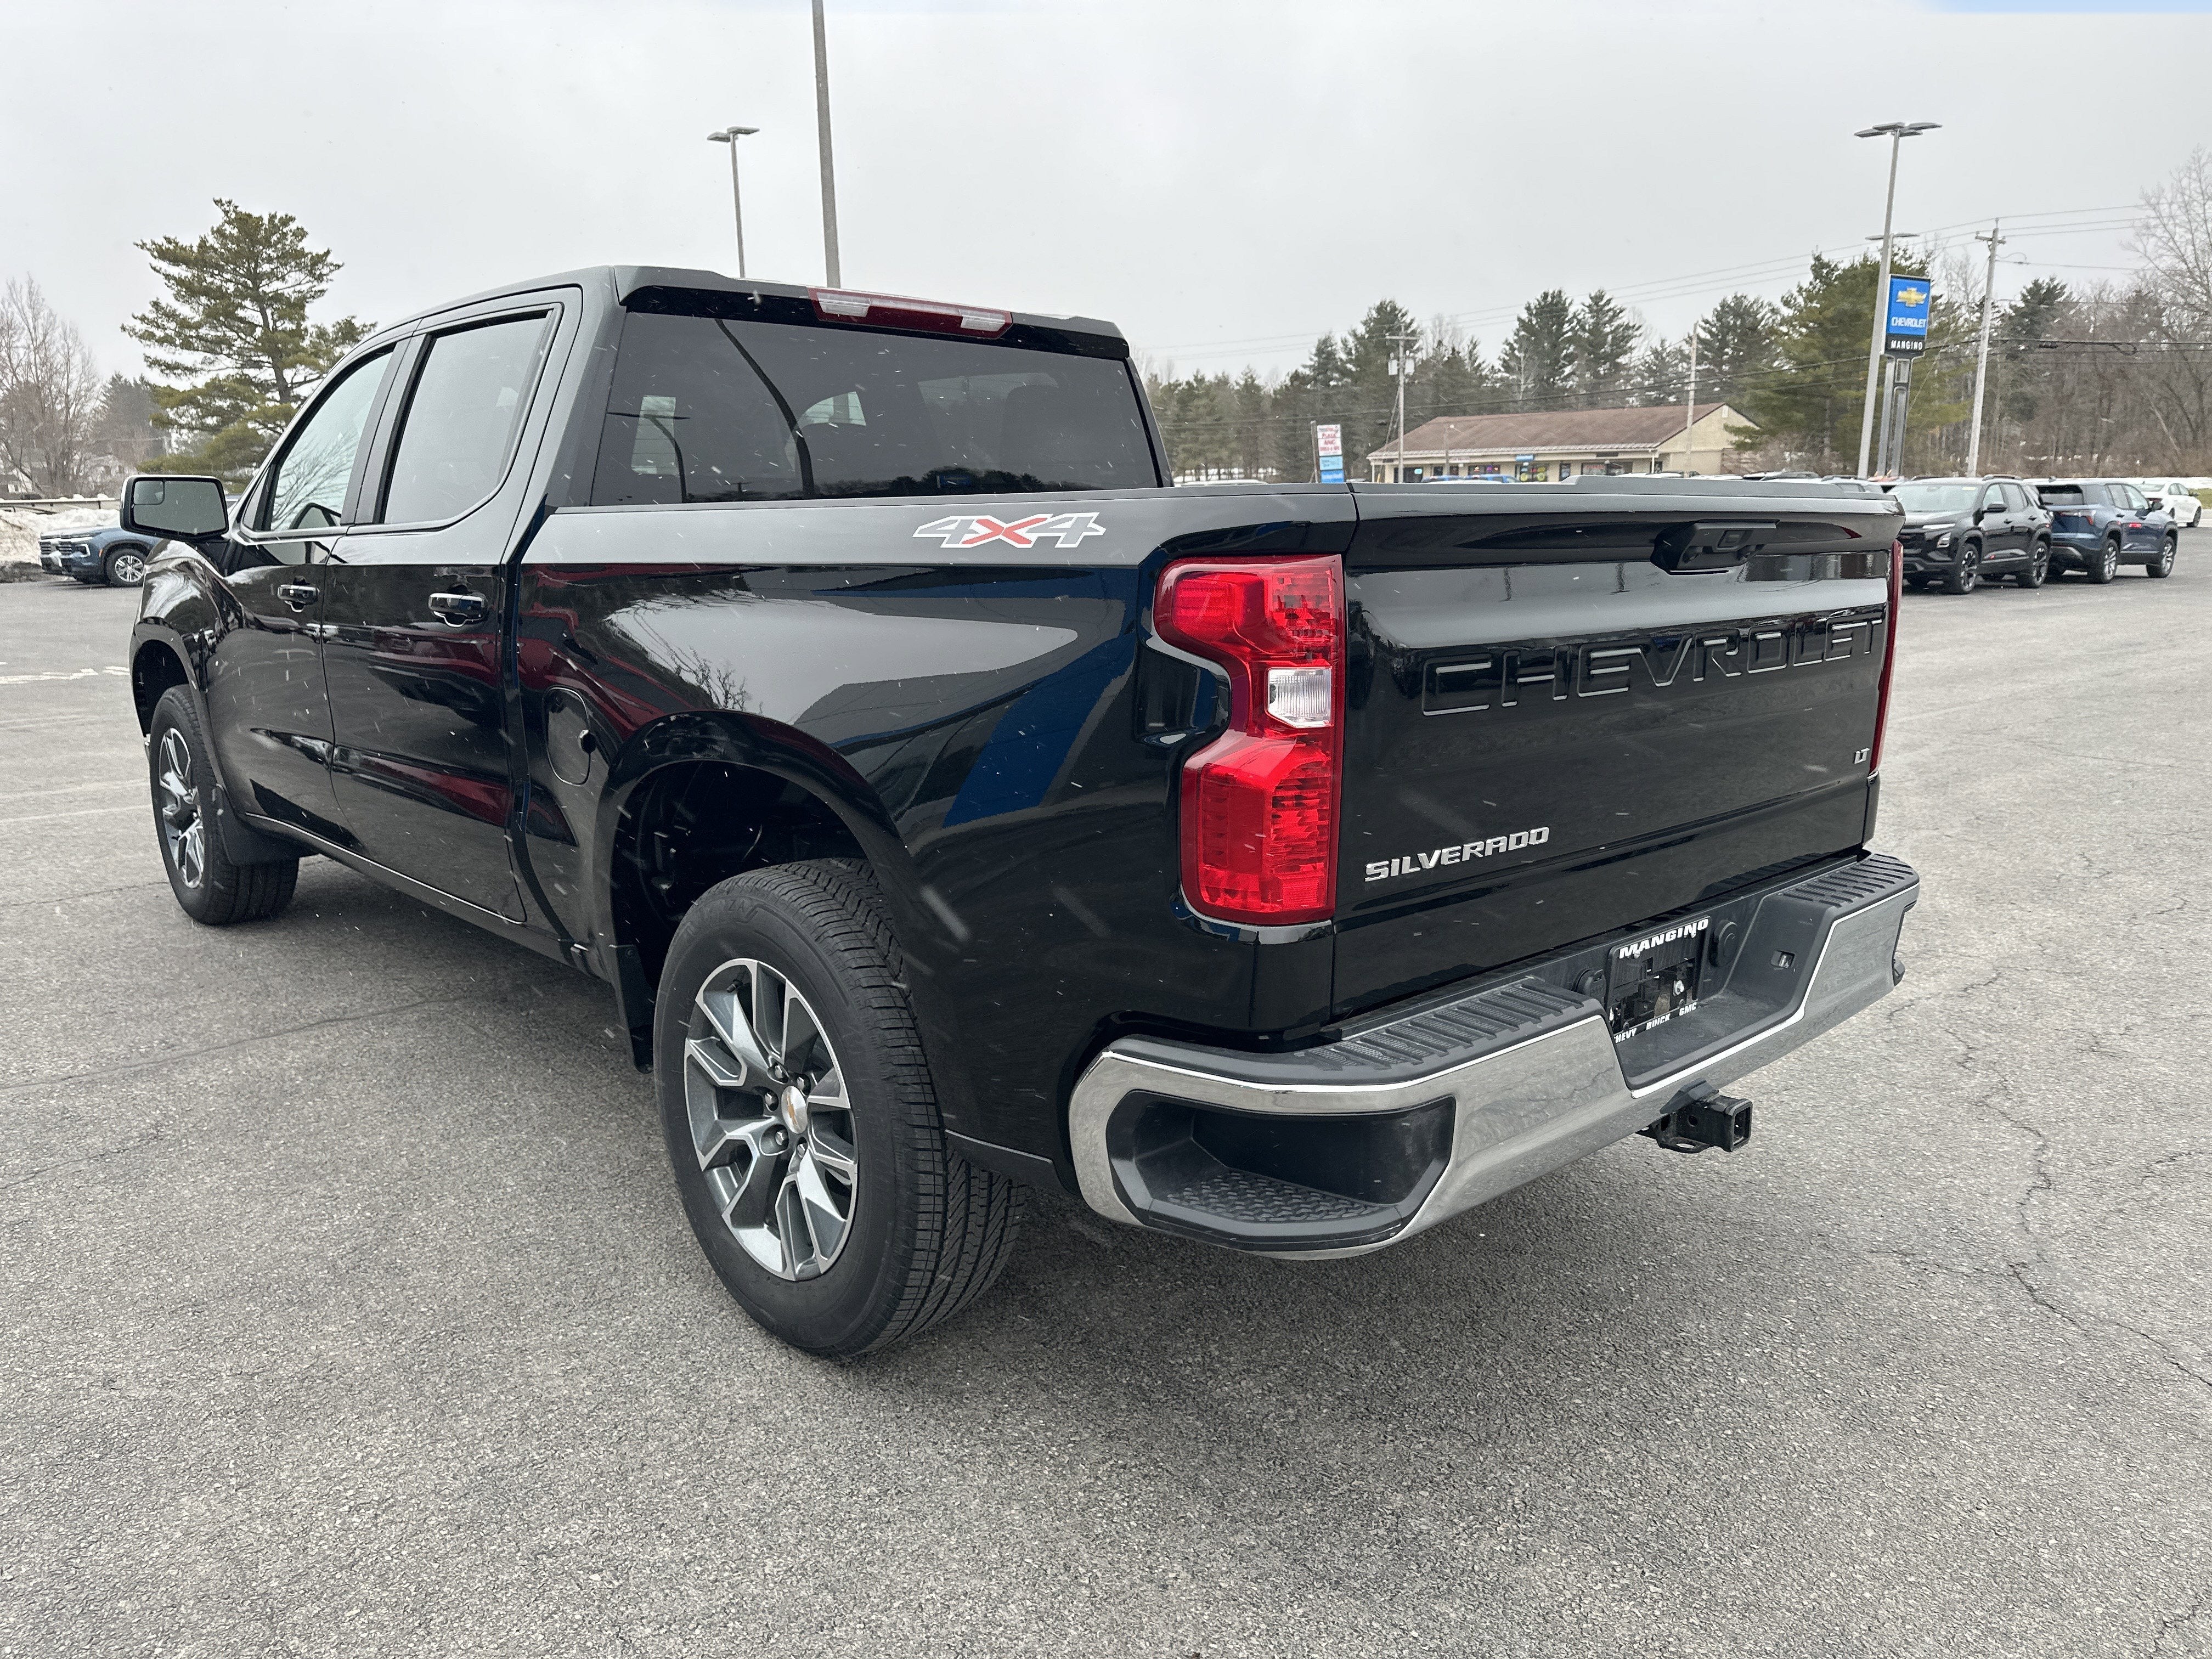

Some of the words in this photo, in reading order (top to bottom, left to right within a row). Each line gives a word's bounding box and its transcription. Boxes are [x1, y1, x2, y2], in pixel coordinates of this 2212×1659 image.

[1891, 317, 1927, 328] CHEVROLET
[1891, 340, 1923, 350] MANGINO
[1423, 614, 1882, 716] CHEVROLET
[1854, 747, 1870, 764] LT
[1364, 826, 1549, 882] SILVERADO
[1619, 918, 1708, 959] MANGINO
[1613, 1027, 1637, 1043] HEVY
[1646, 1013, 1671, 1031] BUICK
[1679, 1002, 1697, 1016] GMC
